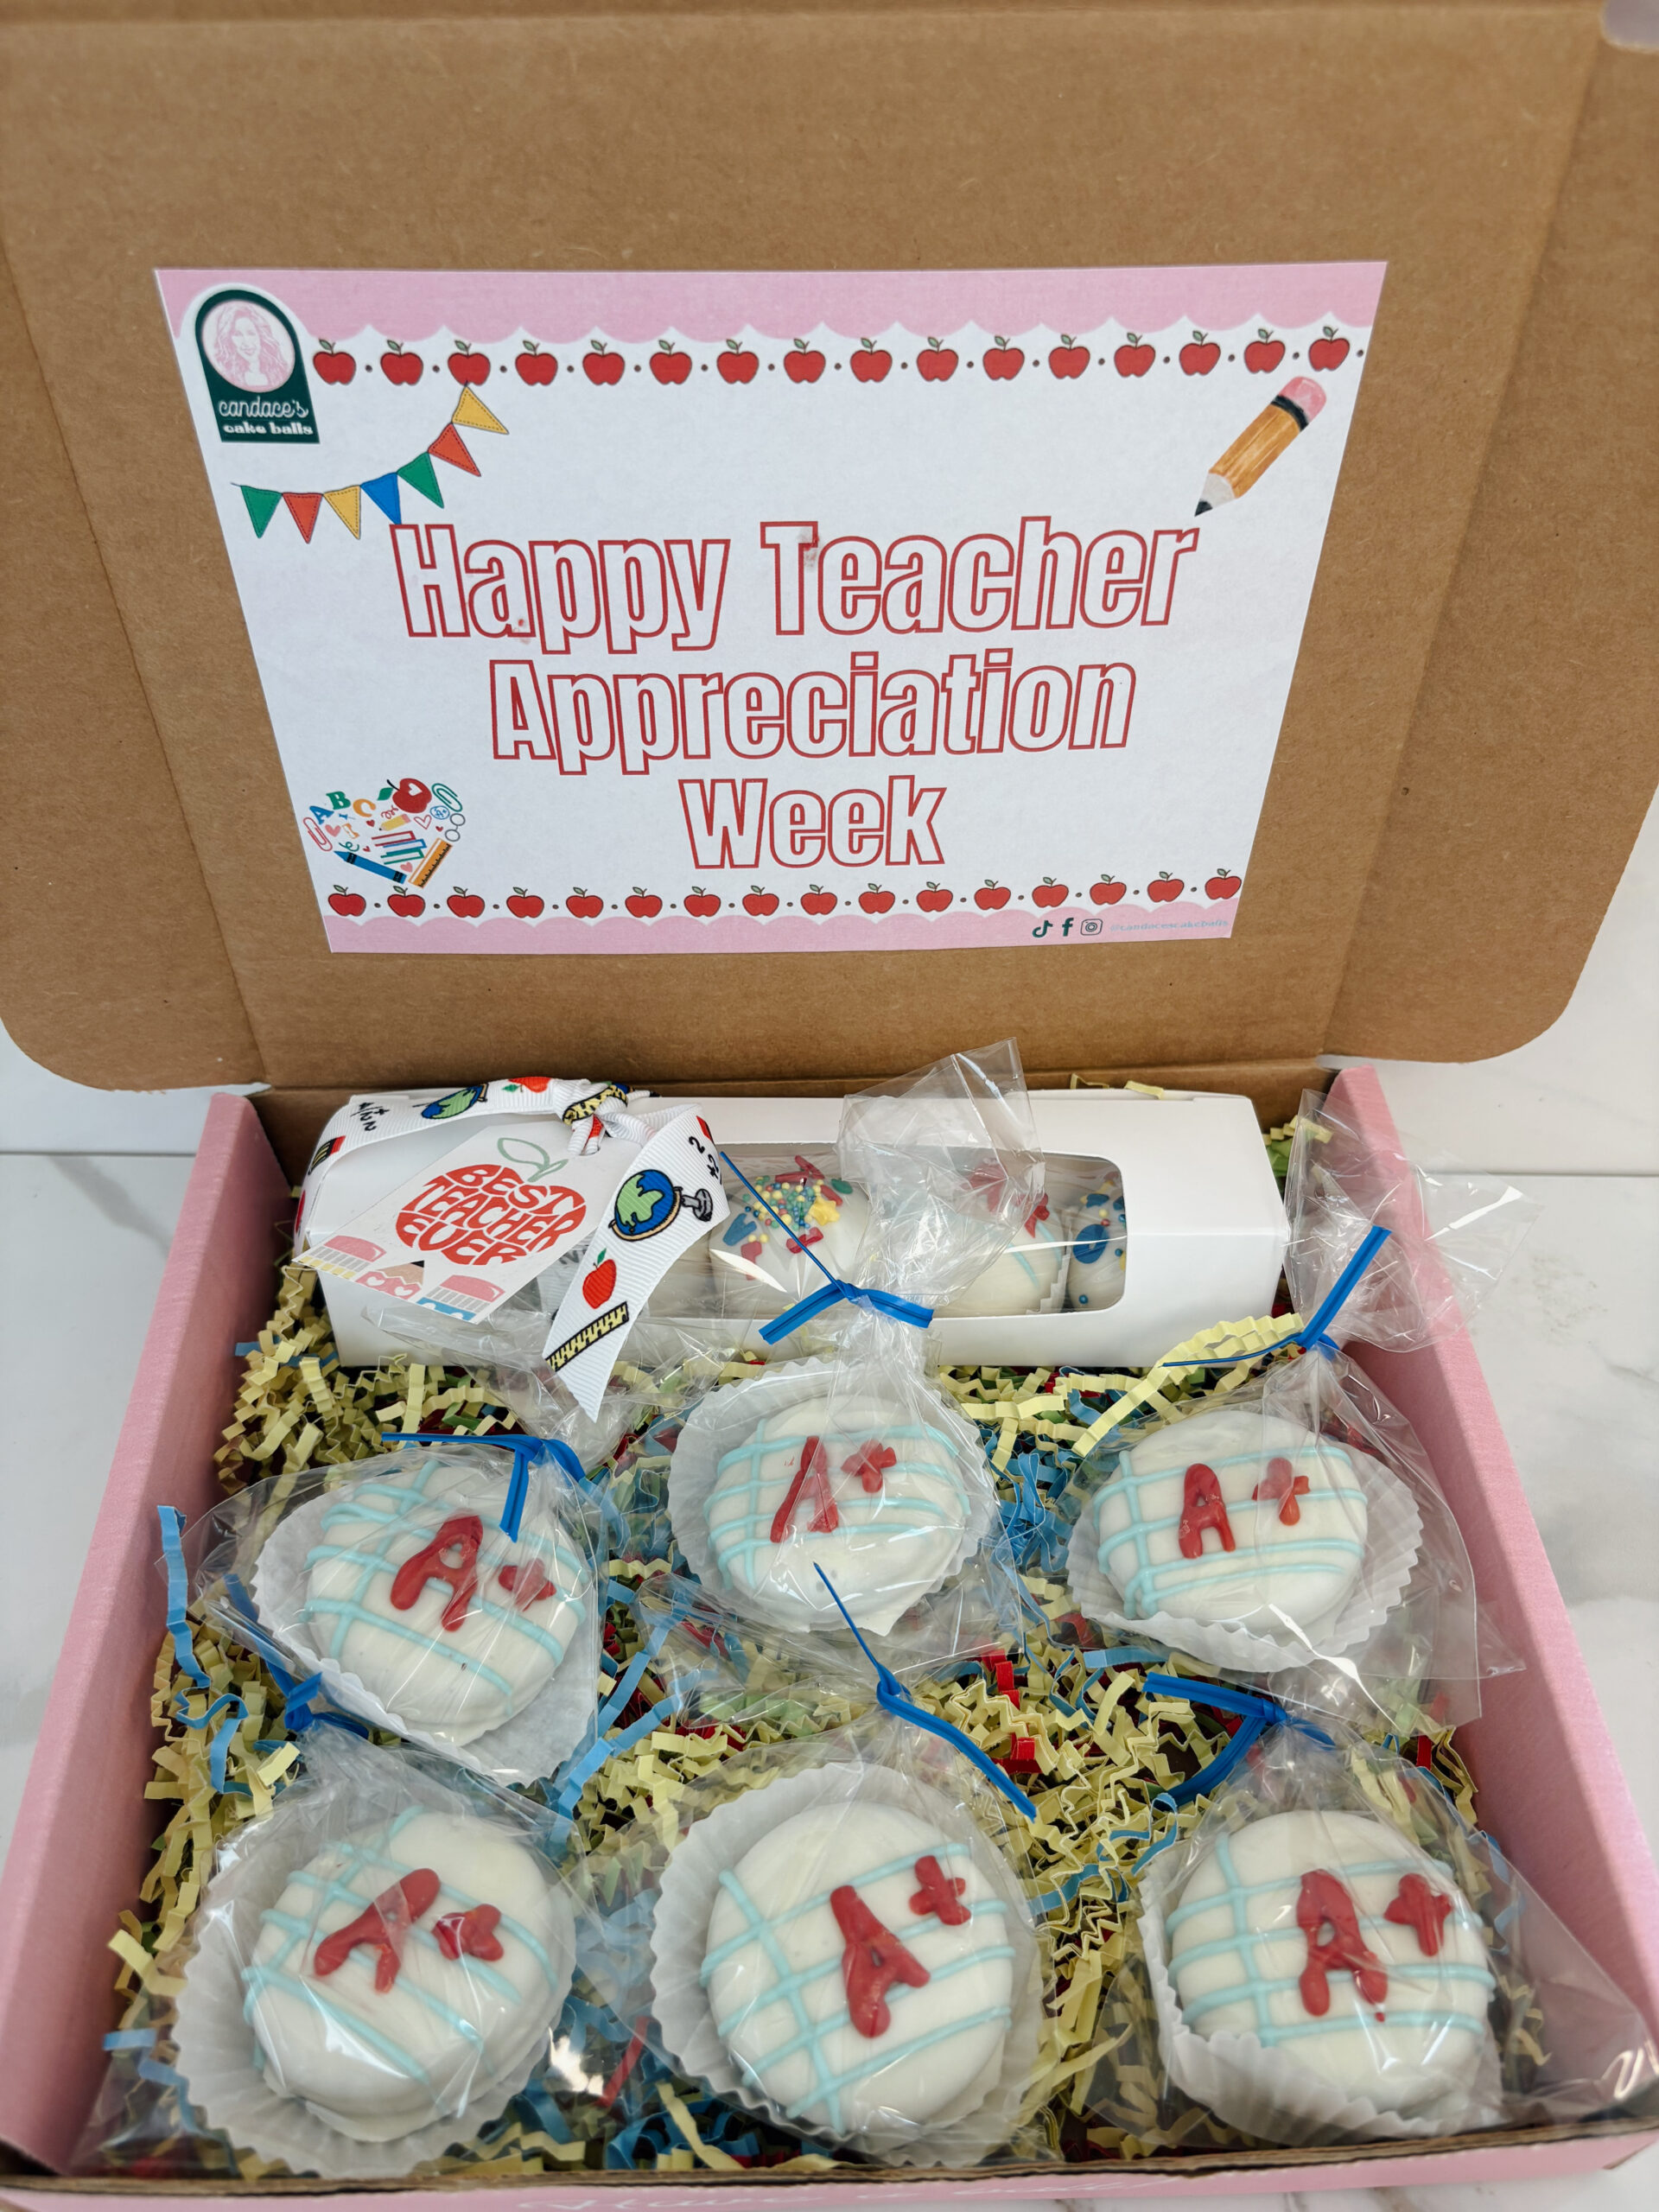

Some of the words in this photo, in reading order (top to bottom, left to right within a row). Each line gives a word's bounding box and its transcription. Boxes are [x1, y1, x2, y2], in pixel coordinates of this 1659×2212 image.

[219, 395, 309, 418] candace's
[223, 421, 268, 434] cake
[269, 421, 314, 435] balls
[390, 524, 731, 655] Happy
[760, 515, 1201, 636] Teacher
[488, 647, 1136, 776] Appreciation
[677, 774, 947, 870] Week
[401, 1174, 587, 1253] TEACHER
[445, 1164, 586, 1215] BEST
